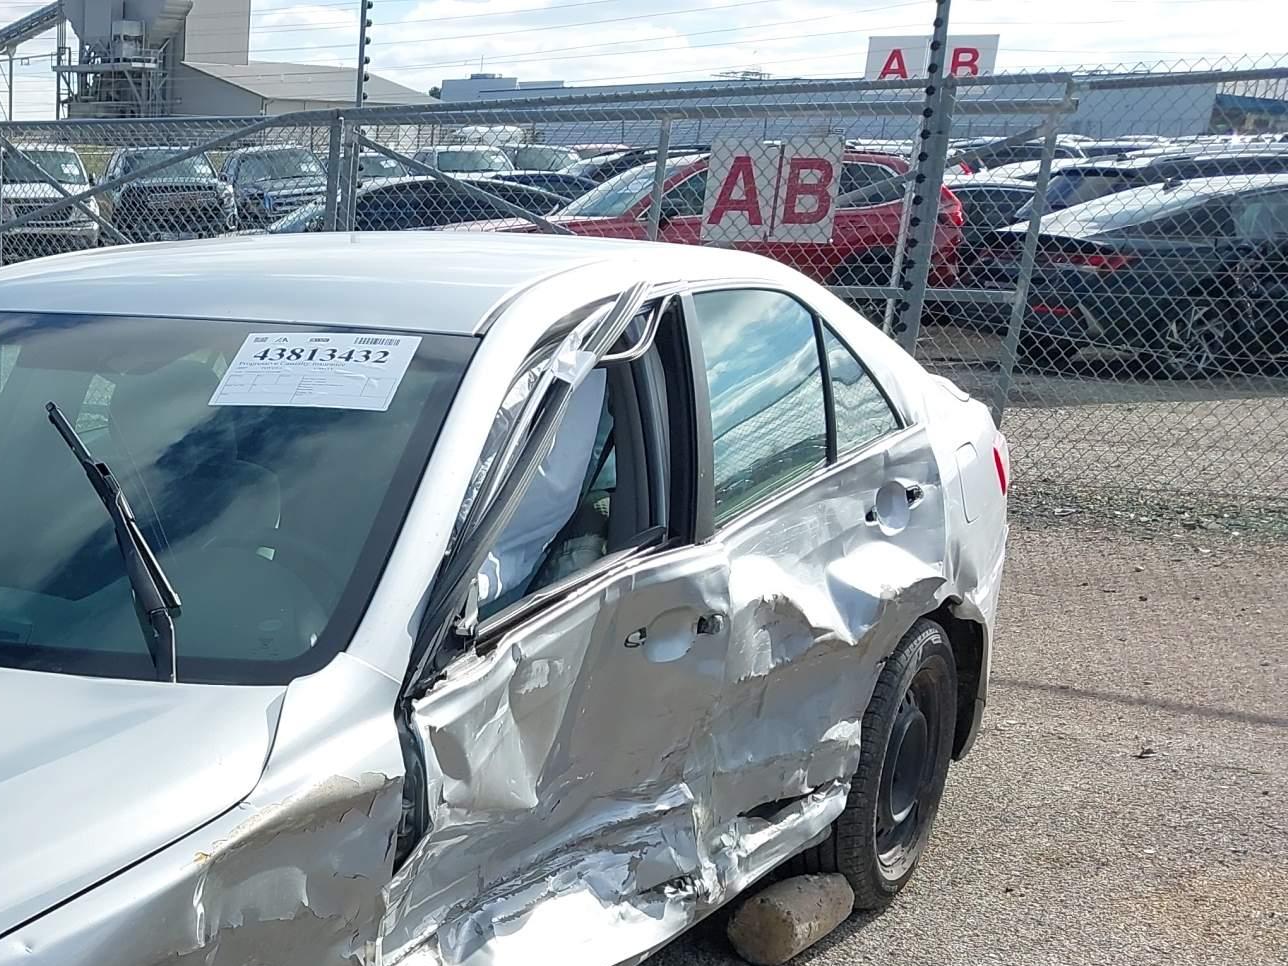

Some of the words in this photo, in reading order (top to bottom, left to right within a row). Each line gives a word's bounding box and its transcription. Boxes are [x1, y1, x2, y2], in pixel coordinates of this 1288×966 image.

[880, 49, 908, 79] A
[707, 156, 762, 225] A
[781, 158, 834, 224] B
[253, 347, 390, 364] 43813432
